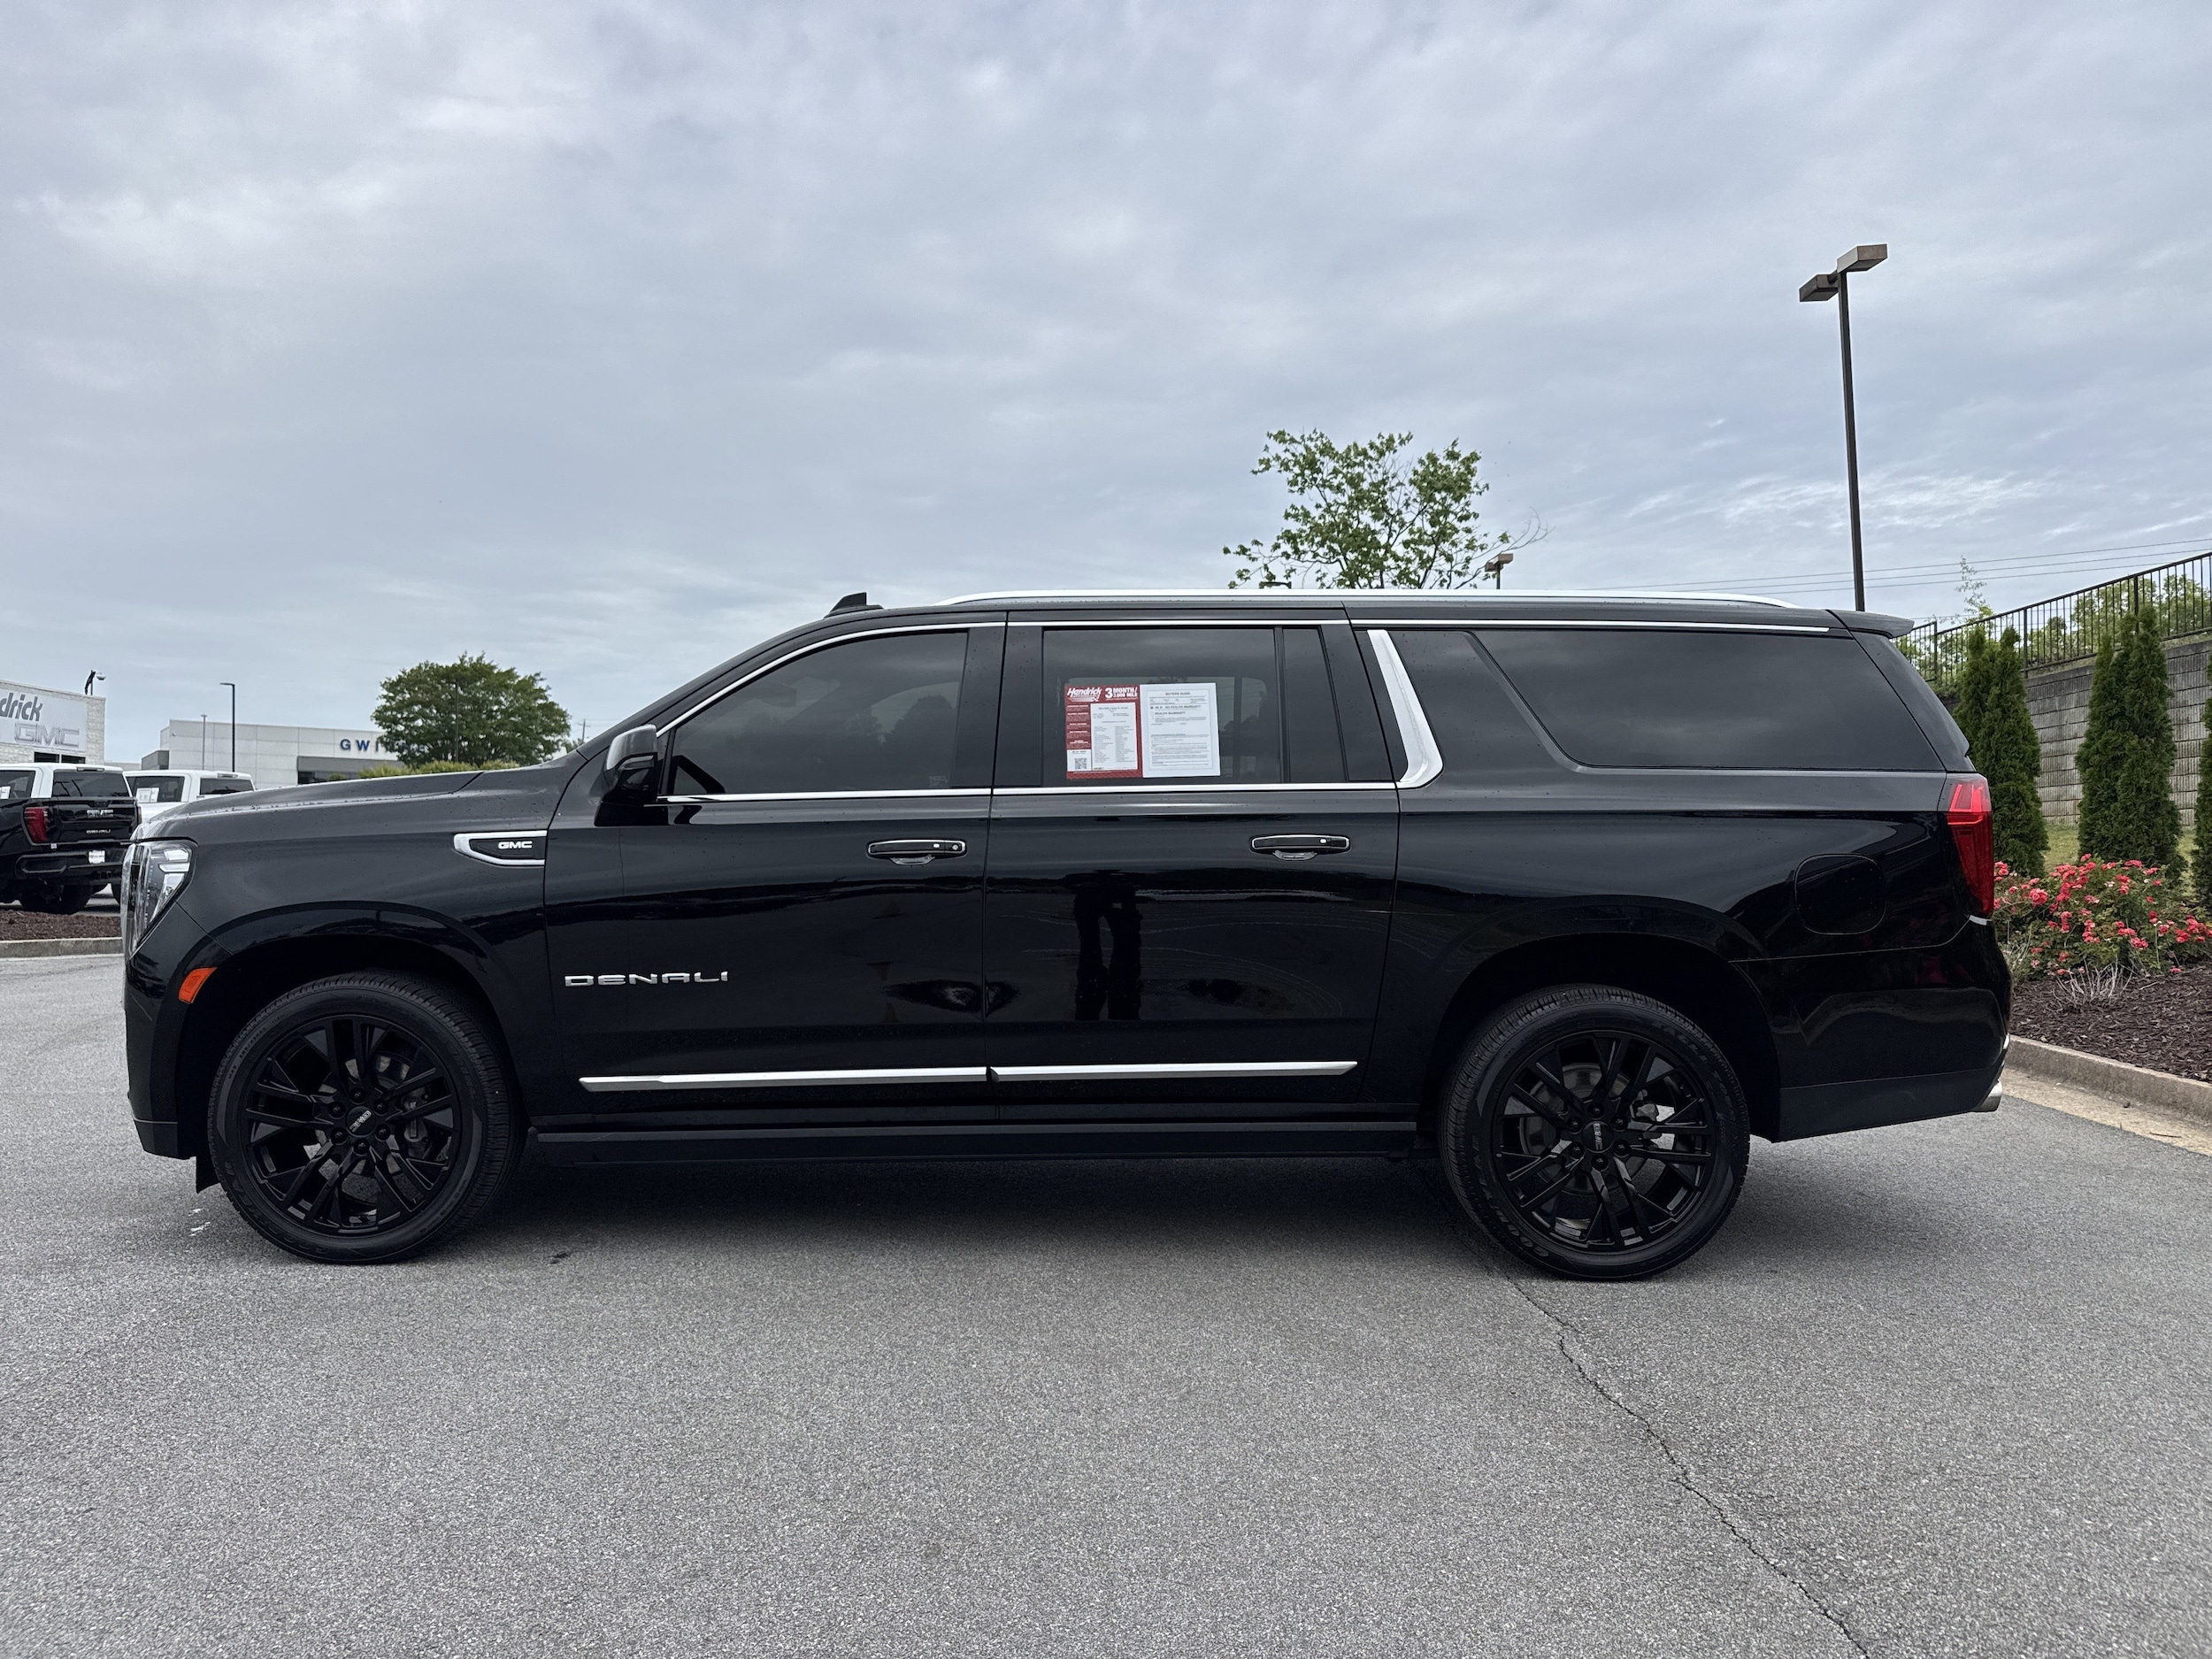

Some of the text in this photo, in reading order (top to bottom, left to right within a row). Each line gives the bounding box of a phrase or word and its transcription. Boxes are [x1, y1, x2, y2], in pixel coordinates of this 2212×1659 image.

[1067, 687, 1102, 702] Hendrick
[1105, 687, 1114, 699] 3
[14, 722, 80, 749] GMC
[498, 841, 533, 849] GMC
[565, 972, 728, 987] DENALI
[1594, 1123, 1603, 1150] GMC
